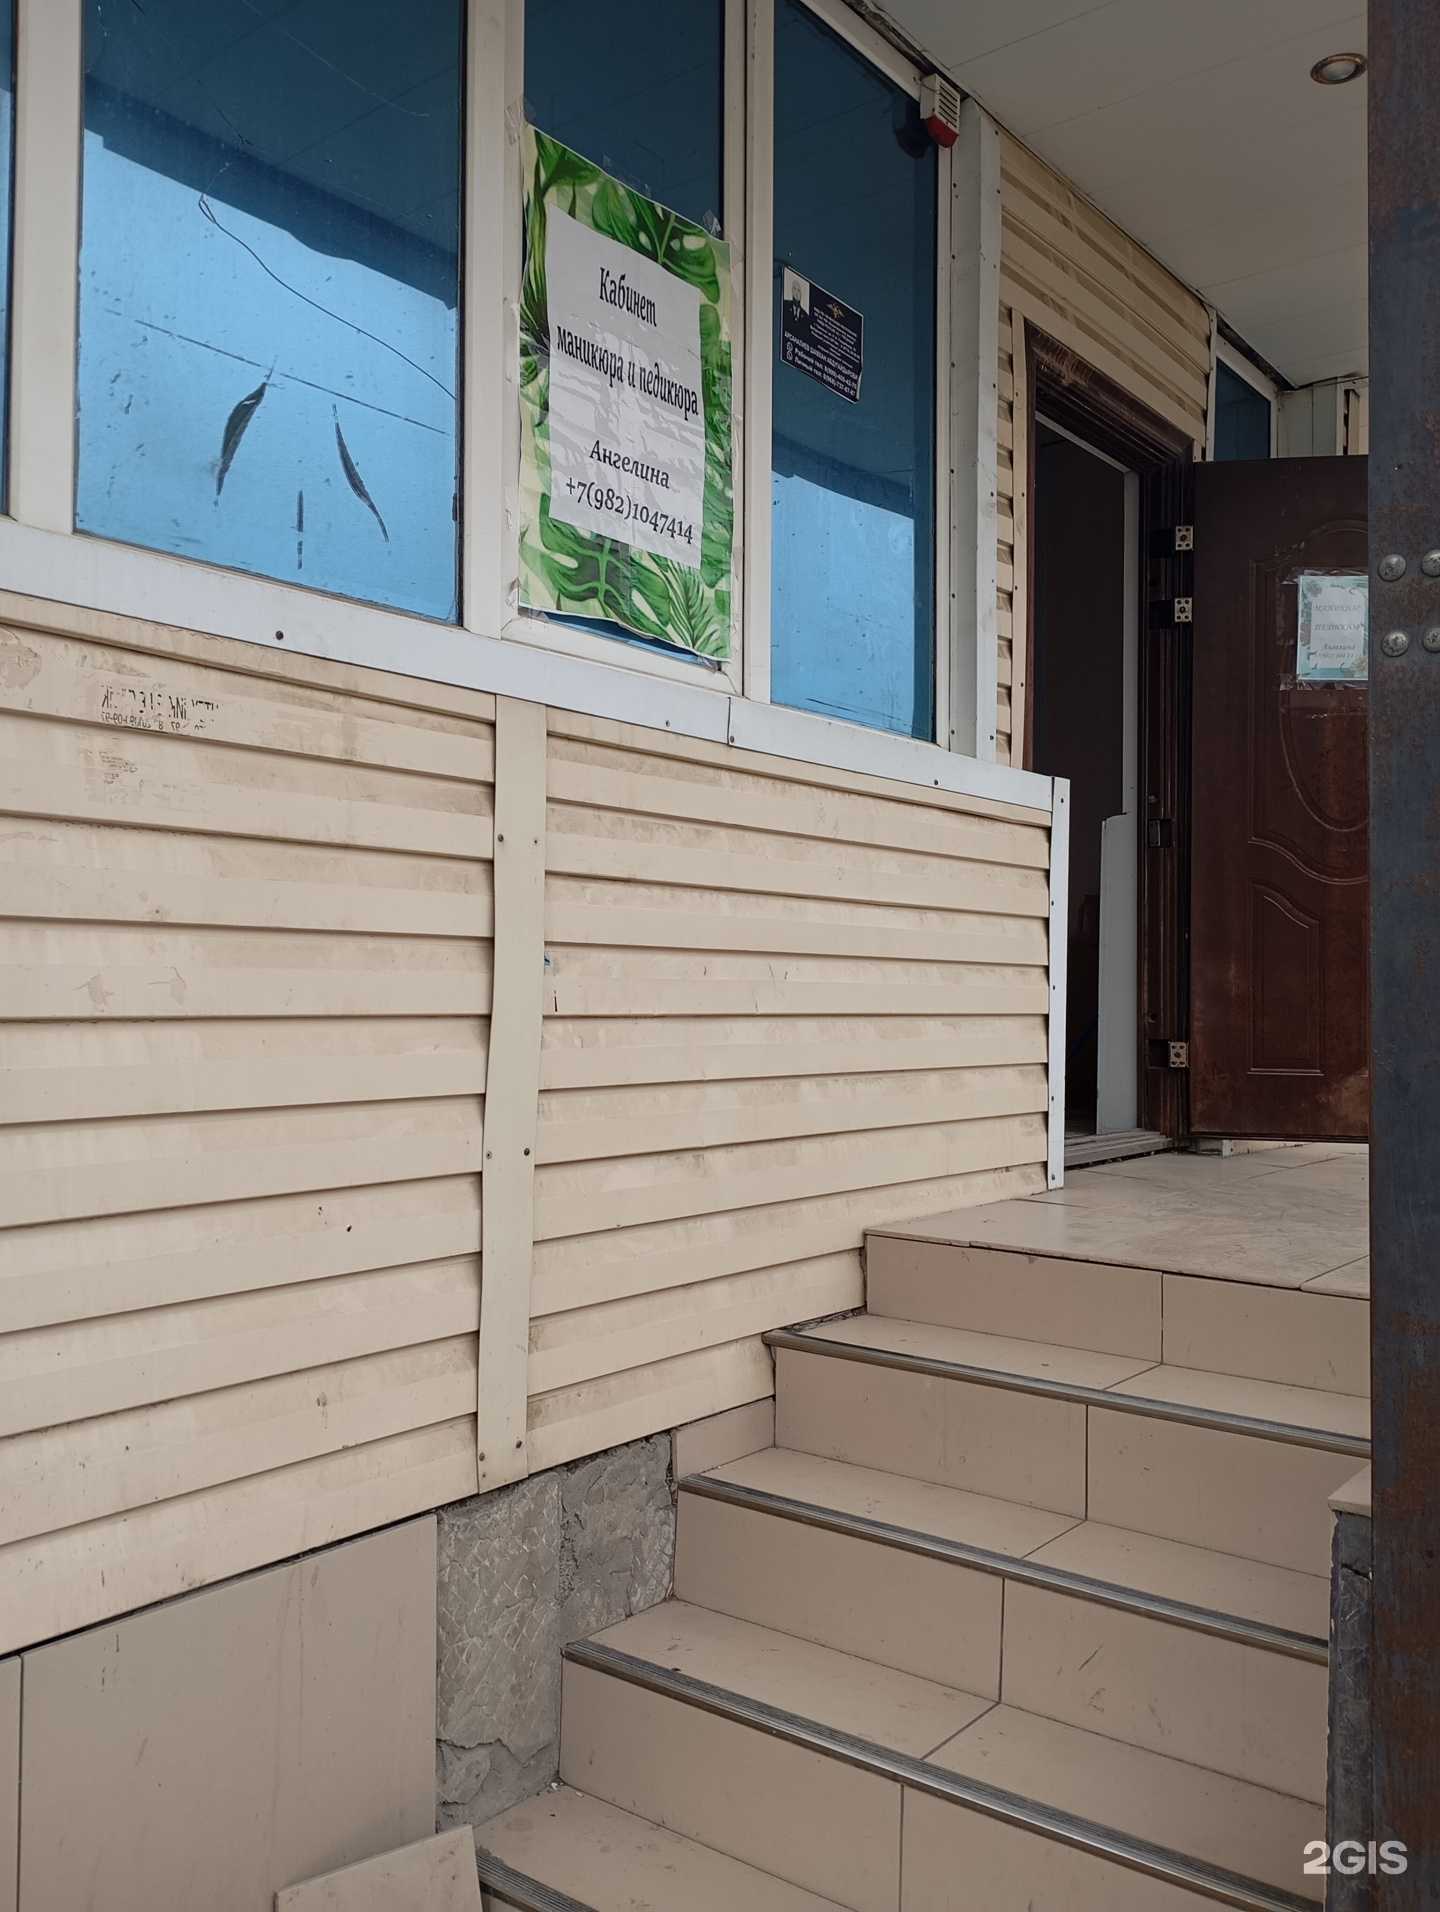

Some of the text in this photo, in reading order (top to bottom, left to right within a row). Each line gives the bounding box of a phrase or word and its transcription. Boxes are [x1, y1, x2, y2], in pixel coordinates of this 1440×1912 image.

[600, 267, 657, 327] Кабинет
[557, 326, 699, 421] маникюра и педикюра
[590, 440, 669, 488] Ангелина
[566, 477, 693, 544] +7(982)1047414
